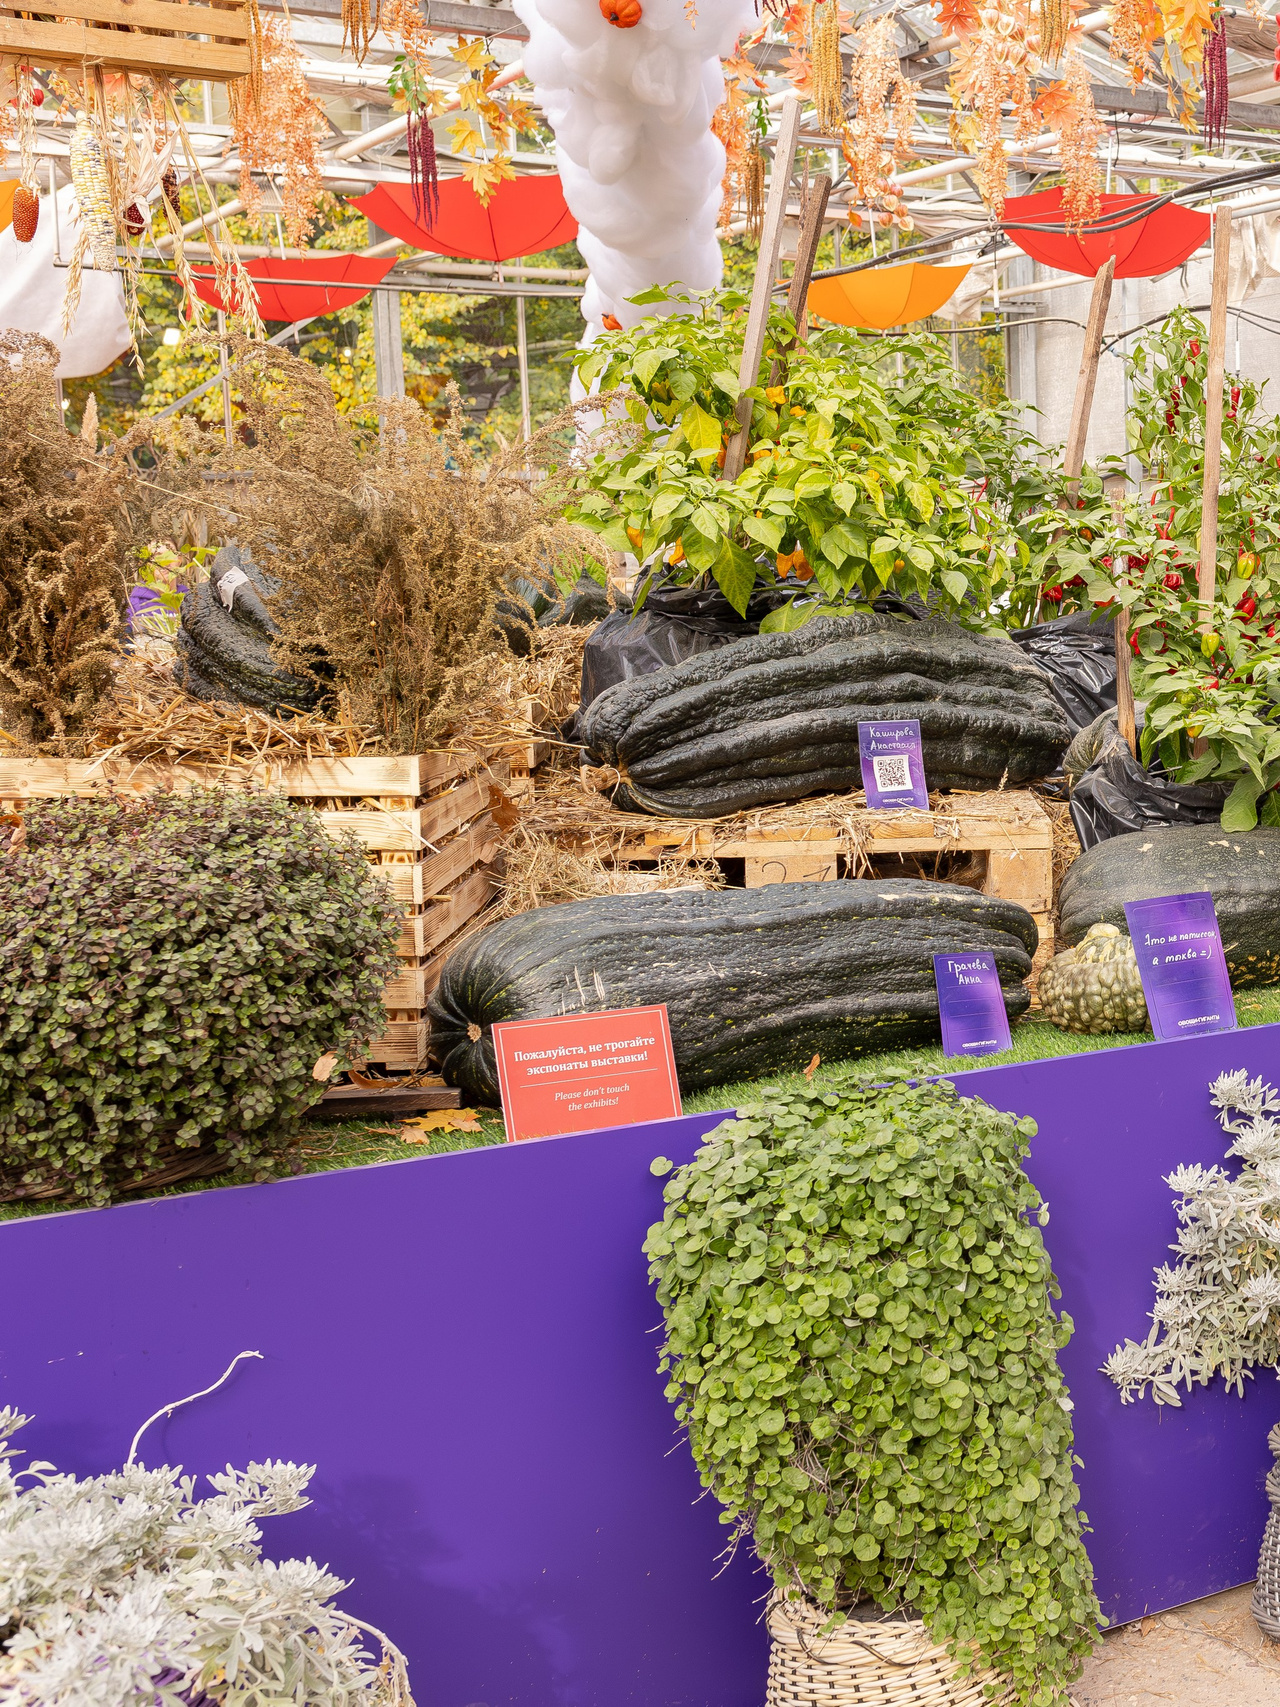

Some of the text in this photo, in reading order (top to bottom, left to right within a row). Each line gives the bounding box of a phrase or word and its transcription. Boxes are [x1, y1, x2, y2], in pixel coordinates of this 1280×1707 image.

[869, 726, 914, 741] Каширова
[1144, 933, 1166, 947] Это
[1168, 935, 1178, 943] не
[1152, 956, 1159, 966] а
[1165, 948, 1197, 964] тыква
[948, 958, 990, 978] Грачева
[958, 973, 983, 985] Анна
[514, 1035, 656, 1062] Пожалуйста, не трогайте
[526, 1050, 648, 1076] экспонаты выставки!
[554, 1087, 582, 1101] Please
[606, 1082, 630, 1095] touch
[568, 1096, 619, 1111] the exhibits!
